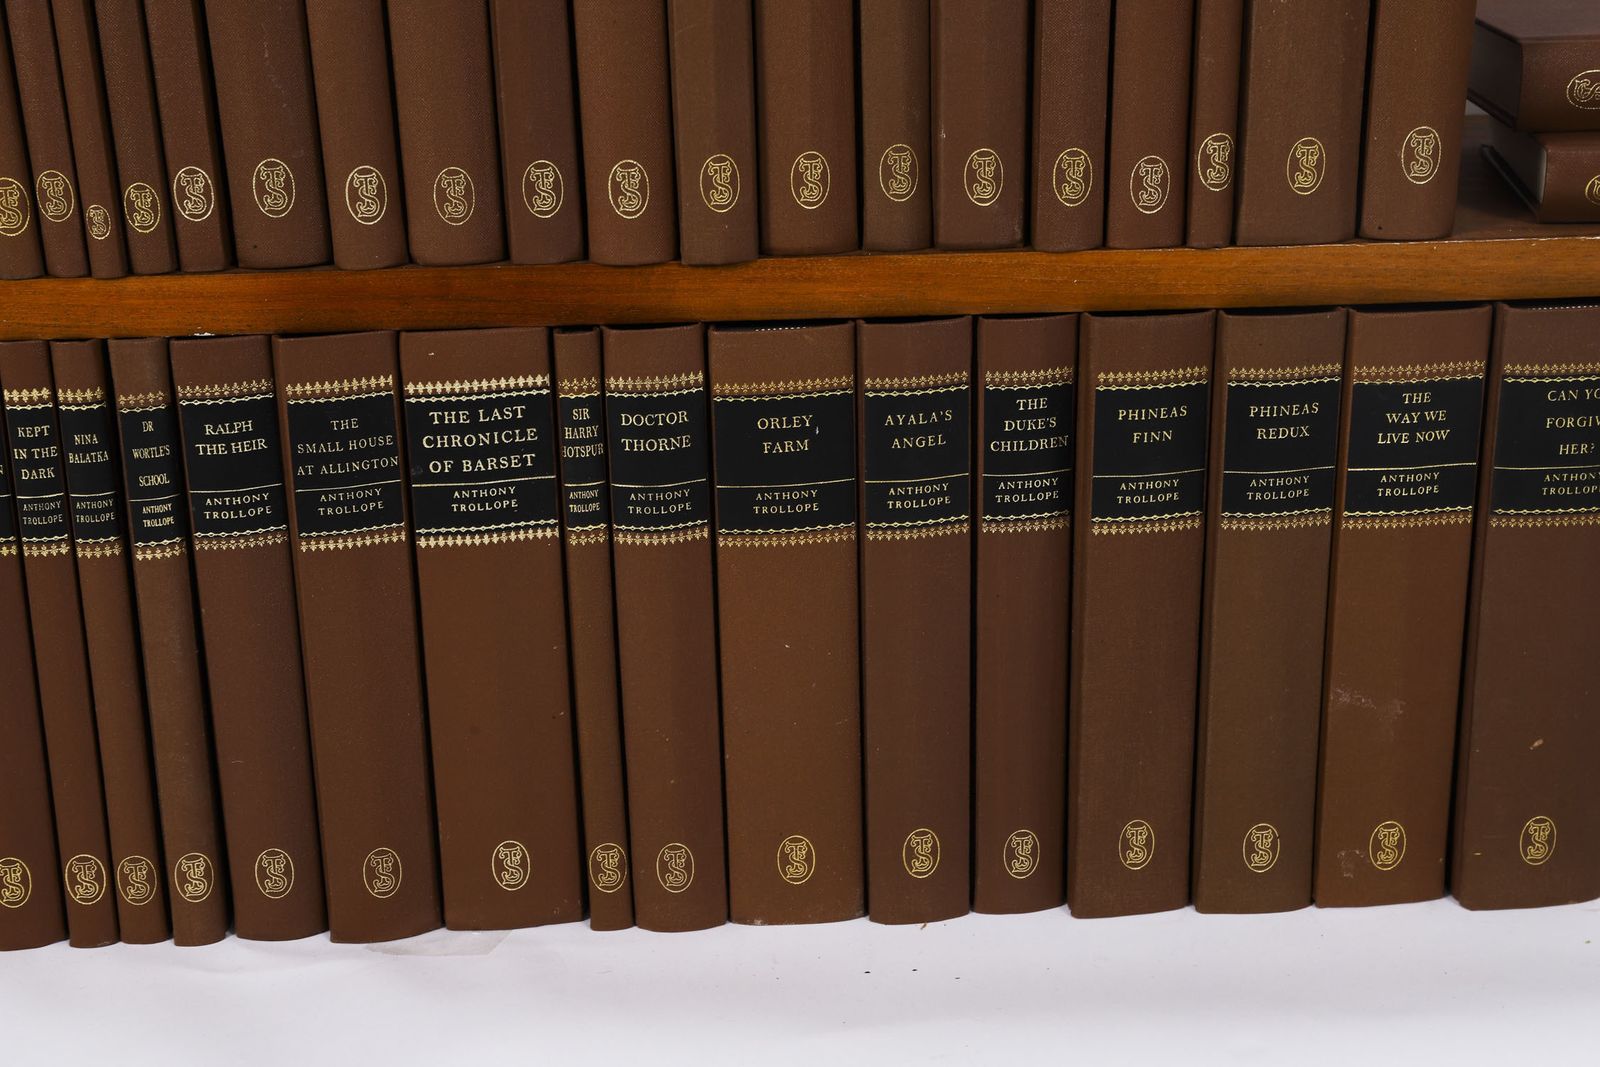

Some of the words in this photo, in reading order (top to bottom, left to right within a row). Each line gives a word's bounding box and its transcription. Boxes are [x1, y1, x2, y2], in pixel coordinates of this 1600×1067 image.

[1403, 392, 1431, 404] THE
[1548, 390, 1578, 401] CAN
[1585, 388, 1600, 399] YO
[1016, 398, 1047, 410] THE
[1250, 403, 1318, 417] PHINEAS
[429, 411, 470, 424] THE
[479, 406, 525, 422] LAST
[573, 408, 590, 420] SIR
[621, 411, 688, 426] DOCTOR
[885, 410, 951, 425] AYALA'S
[1119, 406, 1186, 420] PHINEAS
[1386, 412, 1420, 423] WAY
[1425, 410, 1446, 421] WE
[142, 421, 153, 432] DR
[204, 420, 253, 435] RALPH
[331, 418, 358, 430] THE
[758, 415, 812, 429] ORLEY
[1004, 417, 1056, 431] DUKE'S
[18, 425, 49, 437] KEPT
[565, 426, 598, 439] HARRY
[1133, 430, 1172, 443] FINN
[1257, 426, 1309, 439] REDUX
[1378, 433, 1409, 444] LIVE
[1416, 430, 1450, 442] NOW
[74, 434, 98, 445] NINA
[298, 442, 343, 453] SMALL
[349, 435, 393, 450] HOUSE
[423, 428, 537, 448] CHRONICLE
[621, 435, 691, 451] THORNE
[892, 435, 946, 448] ANGEL
[991, 436, 1068, 451] CHILDREN
[14, 450, 26, 459] IN
[31, 446, 57, 458] THE
[132, 445, 170, 458] WORTLE'S
[195, 444, 227, 455] THE
[231, 439, 267, 453] HEIR
[763, 440, 808, 453] FARM
[1560, 443, 1594, 454] HER?
[69, 451, 108, 463] BALATKA
[298, 465, 313, 475] AT
[321, 456, 398, 474] ALLINGTON
[429, 461, 453, 473] OF
[462, 454, 535, 472] BARSET
[21, 467, 54, 479] DARK
[1381, 472, 1439, 482] ANTHONY
[1545, 472, 1600, 481] ANTHON
[139, 473, 169, 486] SCHOOL
[999, 478, 1058, 489] ANTHONY
[1120, 479, 1178, 490] ANTHONY
[1250, 476, 1309, 487] ANTHONY
[319, 488, 382, 502] ANTHONY
[454, 487, 515, 498] ANTHONY
[569, 490, 598, 499] ANTHONY
[630, 489, 689, 500] ANTHONY
[756, 490, 817, 500] ANTHONY
[889, 483, 948, 495] ANTHONY
[1247, 489, 1309, 500] TROLLOPE
[1377, 485, 1439, 496] TROLLOPE
[1543, 486, 1600, 495] TROLLOP
[205, 493, 269, 505] ANTHONY
[887, 497, 950, 508] TROLLOPE
[996, 491, 1058, 502] TROLLOPE
[1117, 493, 1178, 503] TROLLOPE
[24, 501, 60, 511] ANTHONY
[76, 499, 112, 509] ANTHONY
[143, 503, 171, 513] ANTHONY
[318, 501, 383, 515] TROLLOPE
[452, 499, 518, 511] TROLLOPE
[569, 502, 600, 512] TROLLOPE
[628, 503, 691, 514] TROLLOPE
[753, 503, 818, 513] TROLLOPE
[76, 512, 114, 522] TROLLOPE
[204, 506, 271, 519] TROLLOPE
[23, 514, 62, 525] TROLLOPE
[143, 517, 174, 527] TROLLOPE
